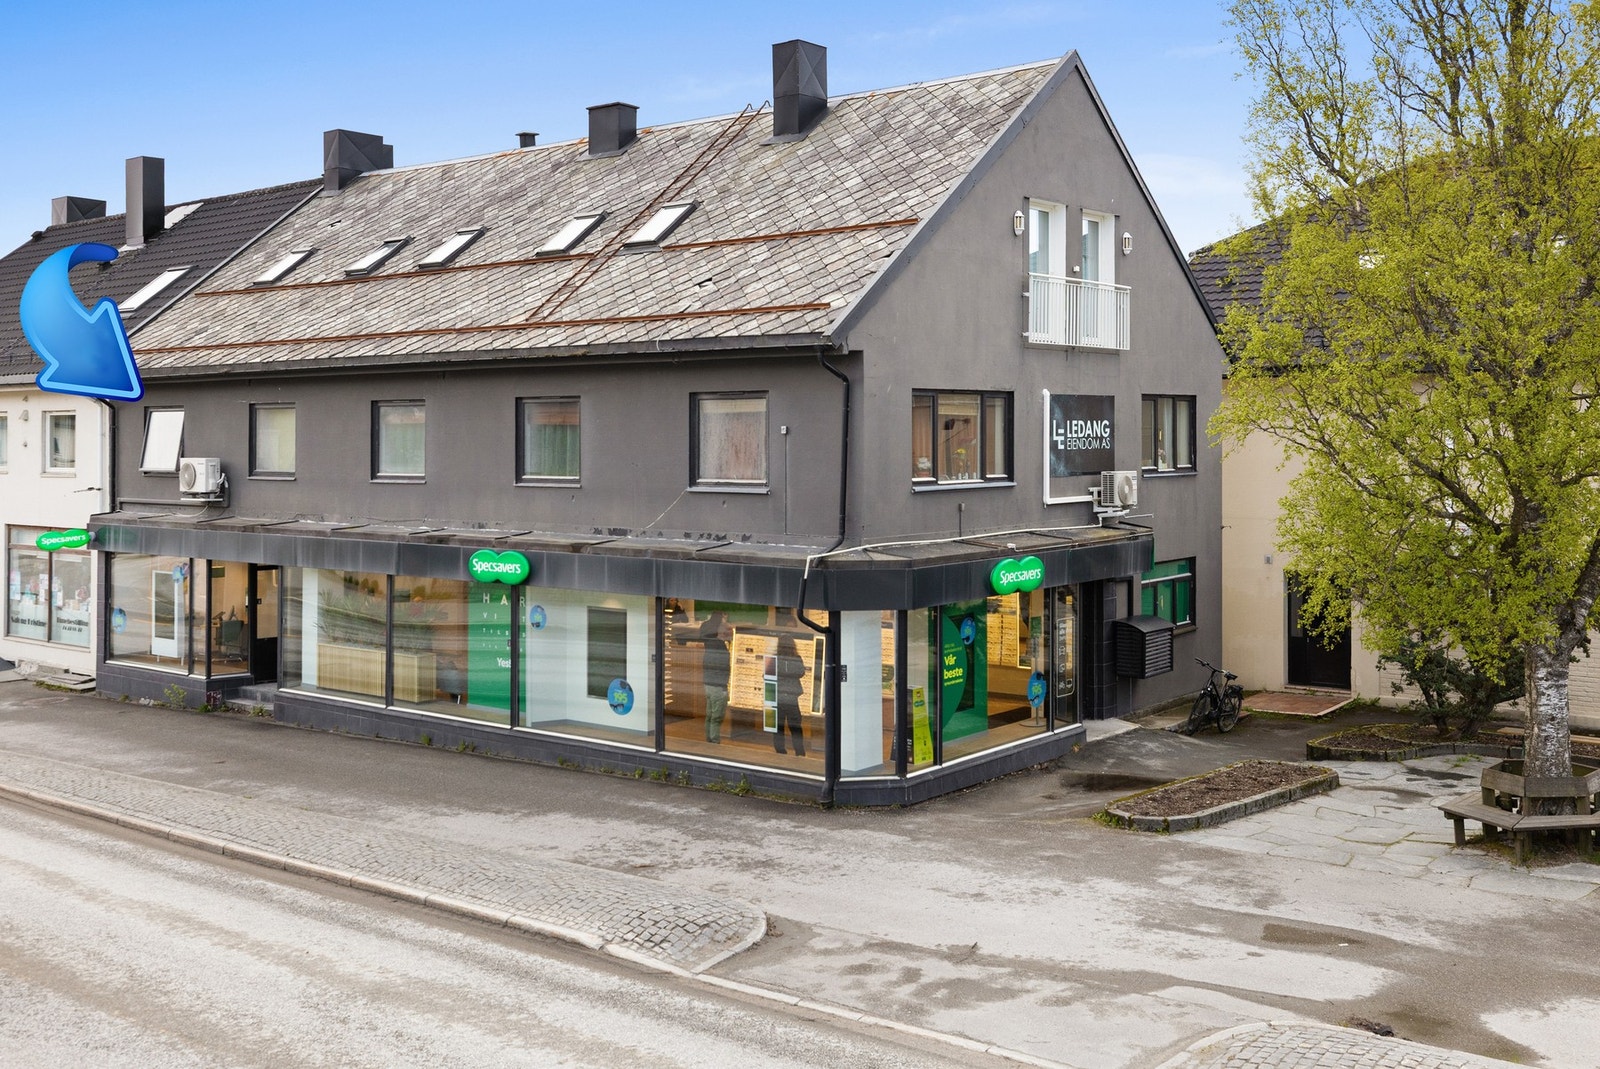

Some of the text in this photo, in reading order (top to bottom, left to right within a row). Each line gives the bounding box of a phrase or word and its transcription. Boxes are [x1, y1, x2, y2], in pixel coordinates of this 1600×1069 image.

[1067, 420, 1110, 438] LEDANG
[1067, 438, 1111, 450] EIENDOM AS
[41, 534, 86, 546] Specsavers
[472, 558, 521, 574] Specsavers
[999, 568, 1041, 586] Specsavers
[944, 654, 957, 666] Vår
[943, 667, 963, 680] beste
